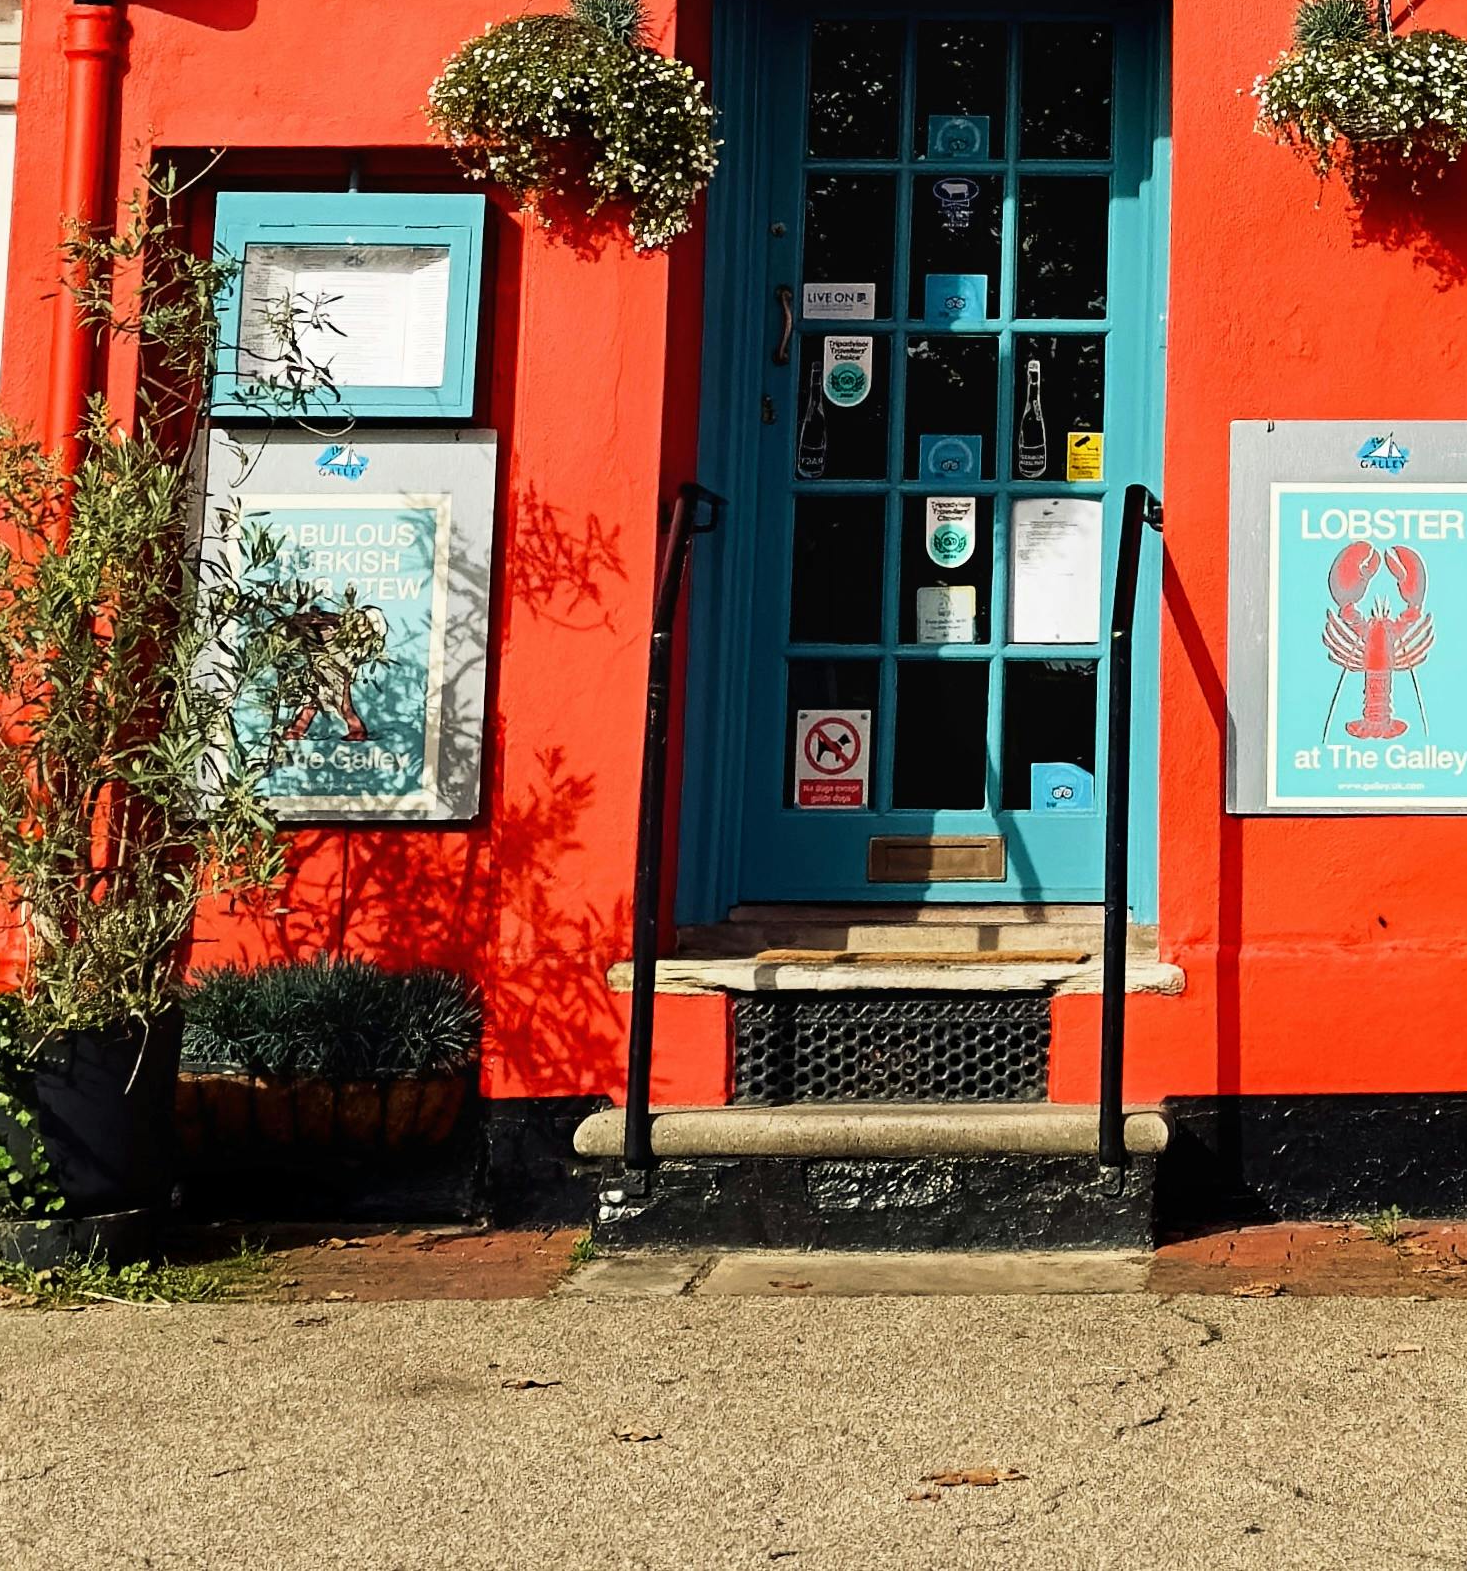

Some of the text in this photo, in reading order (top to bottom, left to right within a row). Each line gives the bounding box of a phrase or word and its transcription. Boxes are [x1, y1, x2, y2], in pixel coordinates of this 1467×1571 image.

[1301, 509, 1465, 540] LOBSTER
[1294, 749, 1321, 769] at
[1327, 745, 1378, 769] The
